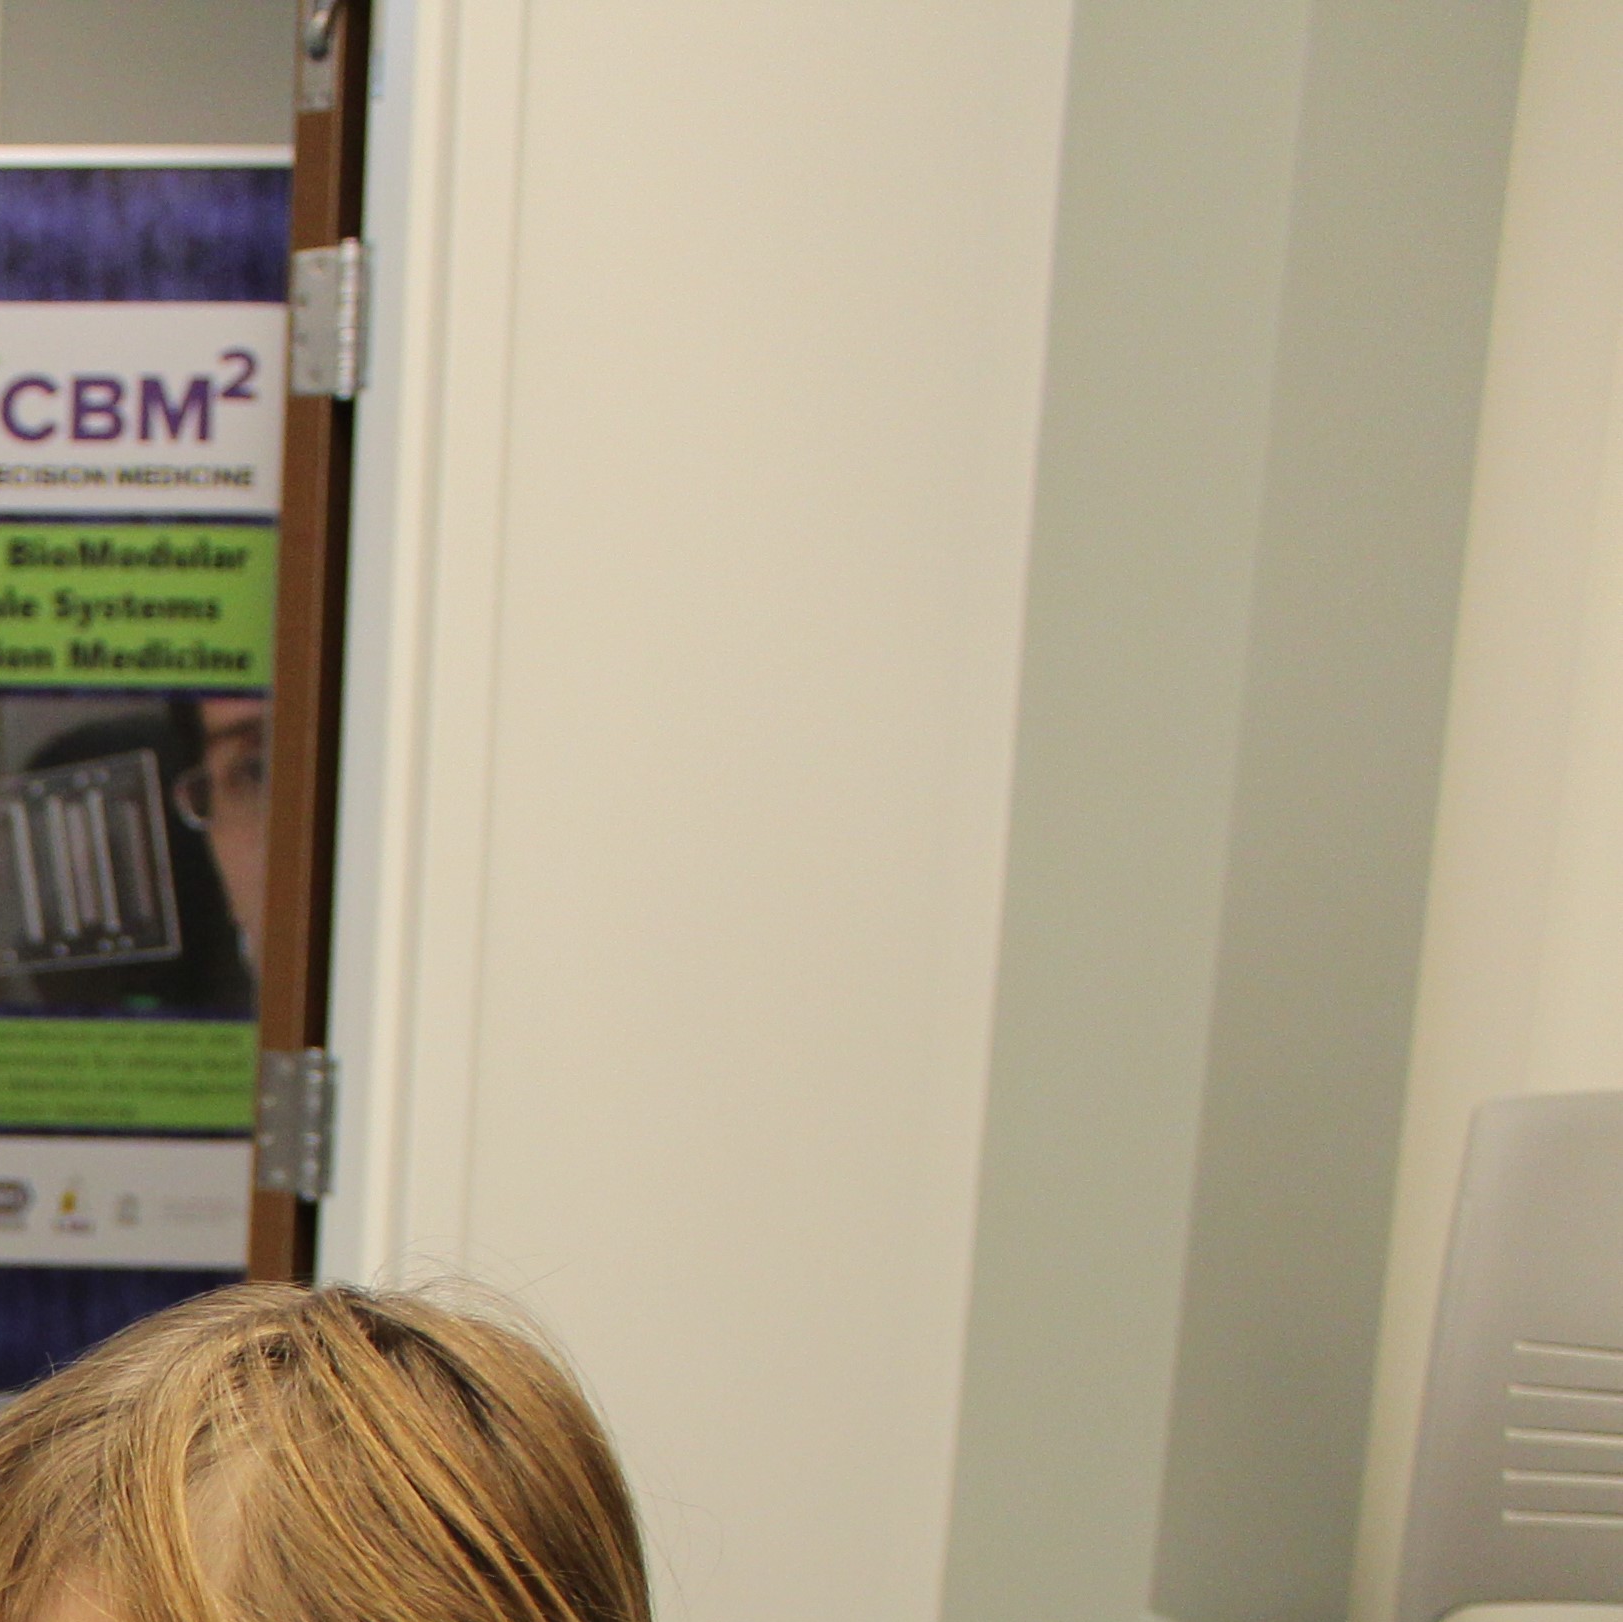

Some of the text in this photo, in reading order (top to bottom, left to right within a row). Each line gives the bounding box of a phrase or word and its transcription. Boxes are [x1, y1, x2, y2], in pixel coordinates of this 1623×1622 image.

[114, 465, 256, 489] MEDICINE
[7, 537, 249, 571] BioModular
[53, 586, 222, 627] Systems
[69, 637, 250, 672] Medicine
